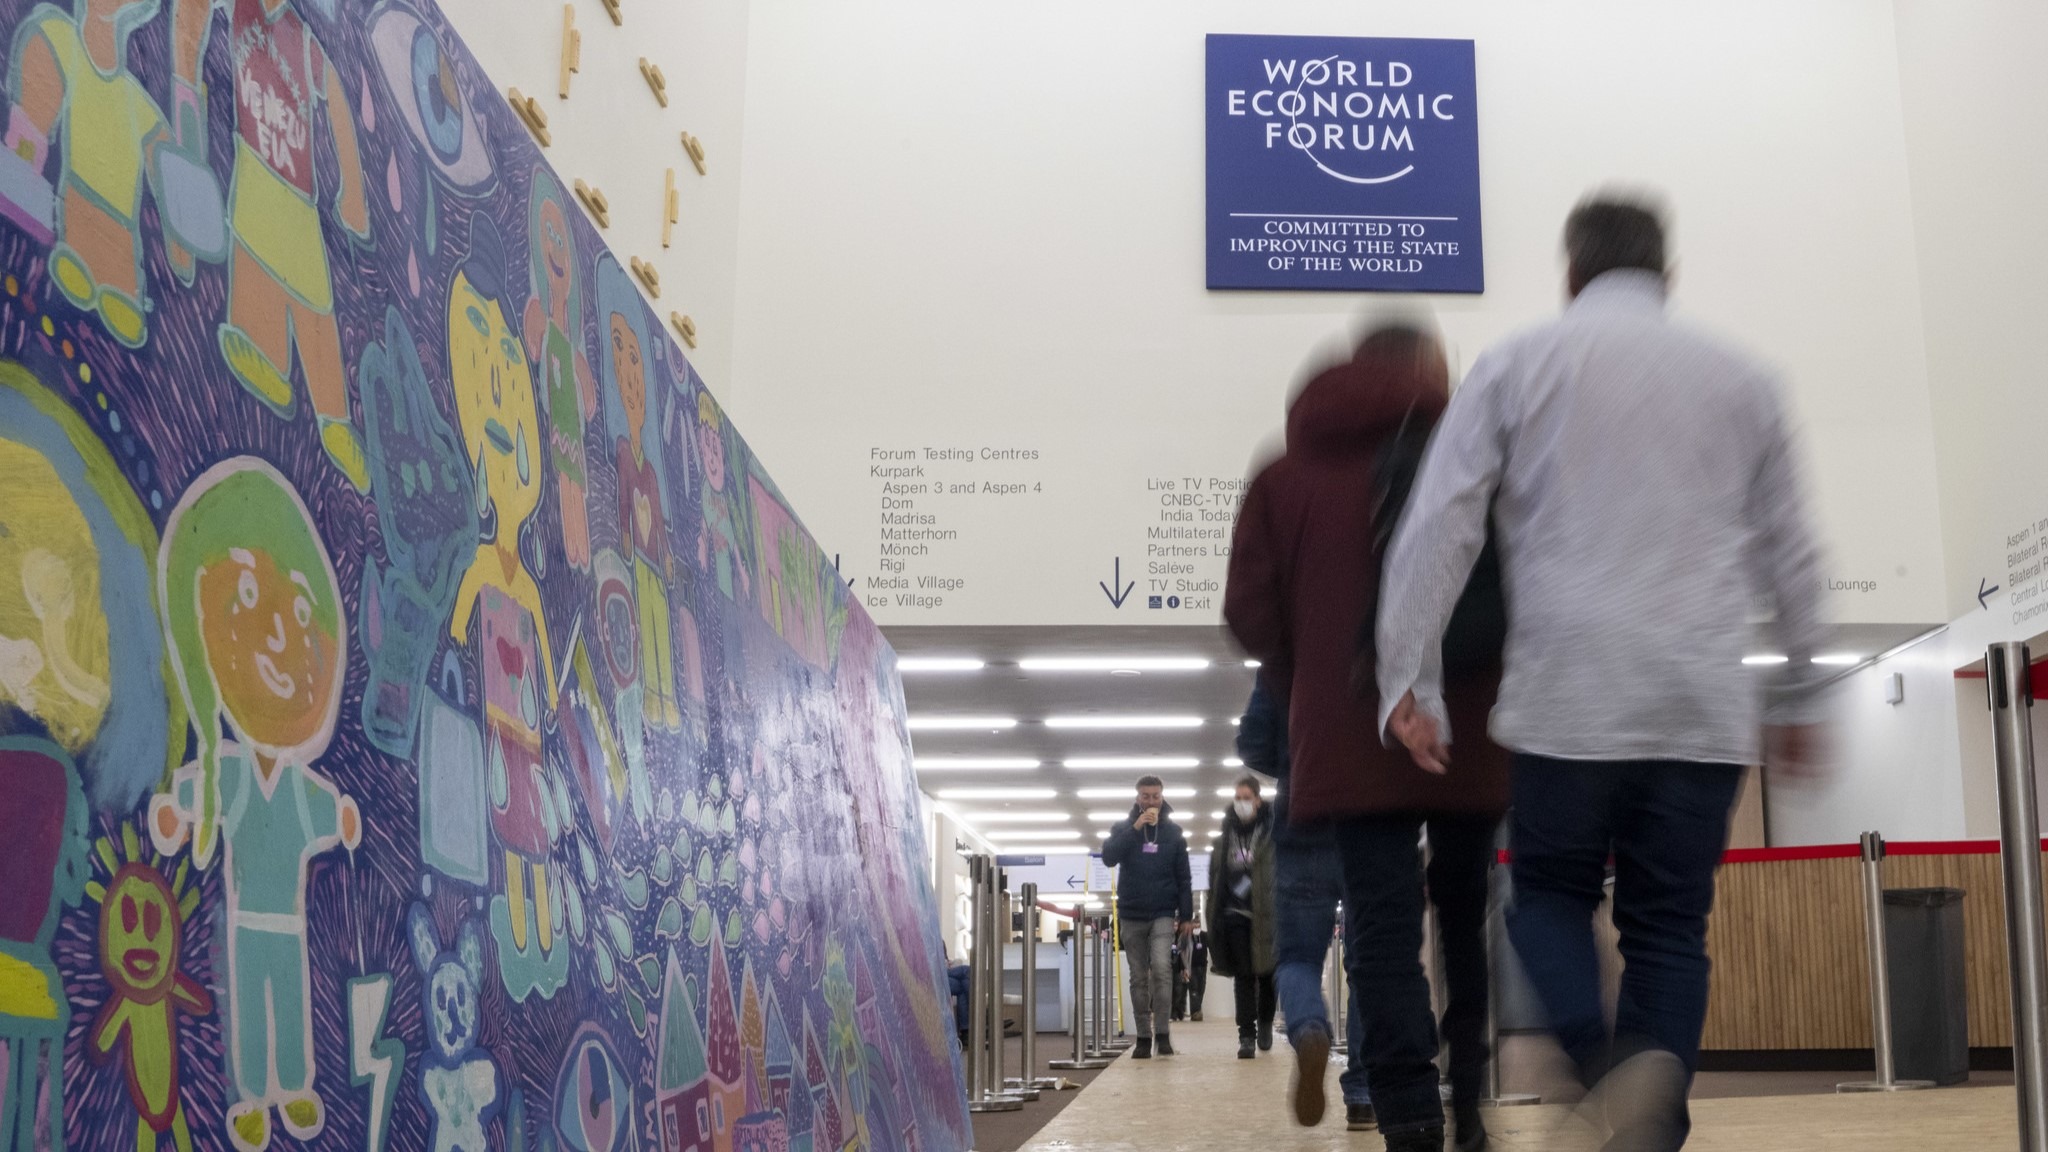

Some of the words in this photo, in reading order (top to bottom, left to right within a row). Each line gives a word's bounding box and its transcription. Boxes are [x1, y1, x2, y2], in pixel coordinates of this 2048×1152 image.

[1263, 58, 1413, 87] WORLD
[1228, 89, 1455, 120] ECONOMIC
[1266, 122, 1414, 151] FORUM
[1264, 221, 1392, 237] COMMITTED
[1398, 223, 1425, 237] TO
[1230, 238, 1347, 253] IMPROVING
[1353, 240, 1395, 254] THE
[1401, 241, 1459, 255] STATE
[1267, 256, 1295, 271] OF
[1301, 257, 1342, 271] THE
[1348, 258, 1423, 273] WORLD
[871, 447, 916, 461] Forum
[923, 447, 974, 462] Testing
[980, 447, 1040, 461] Centres
[870, 465, 925, 480] Kurpark
[882, 482, 927, 496] Aspen
[934, 482, 943, 494] 3
[950, 482, 976, 494] and
[982, 481, 1027, 496] Aspen
[1033, 481, 1043, 494] 4
[1147, 478, 1175, 491] Live
[1183, 478, 1203, 490] TV
[881, 497, 914, 510] Dom
[881, 512, 936, 525] Madrisa
[1160, 509, 1193, 522] India
[1198, 509, 1240, 524] Today
[881, 527, 957, 540] Matterhorn
[1147, 526, 1225, 539] Multilateral
[2007, 528, 2029, 549] Aspen
[2032, 522, 2036, 535] 1
[880, 543, 929, 556] Mönch
[1147, 544, 1207, 557] Partners
[1214, 544, 1233, 557] Lo
[2007, 541, 2039, 568] Bilateral
[880, 558, 906, 573] Rigi
[2009, 559, 2041, 587] Bilateral
[868, 576, 909, 589] Media
[917, 576, 965, 591] Village
[1149, 579, 1168, 592] TV
[1176, 579, 1219, 592] Studio
[1828, 578, 1877, 593] Lounge
[867, 594, 888, 607] Ice
[896, 594, 943, 609] Village
[2011, 583, 2038, 607] Central
[1184, 597, 1211, 609] Exit
[640, 1012, 659, 1152] MBIA
